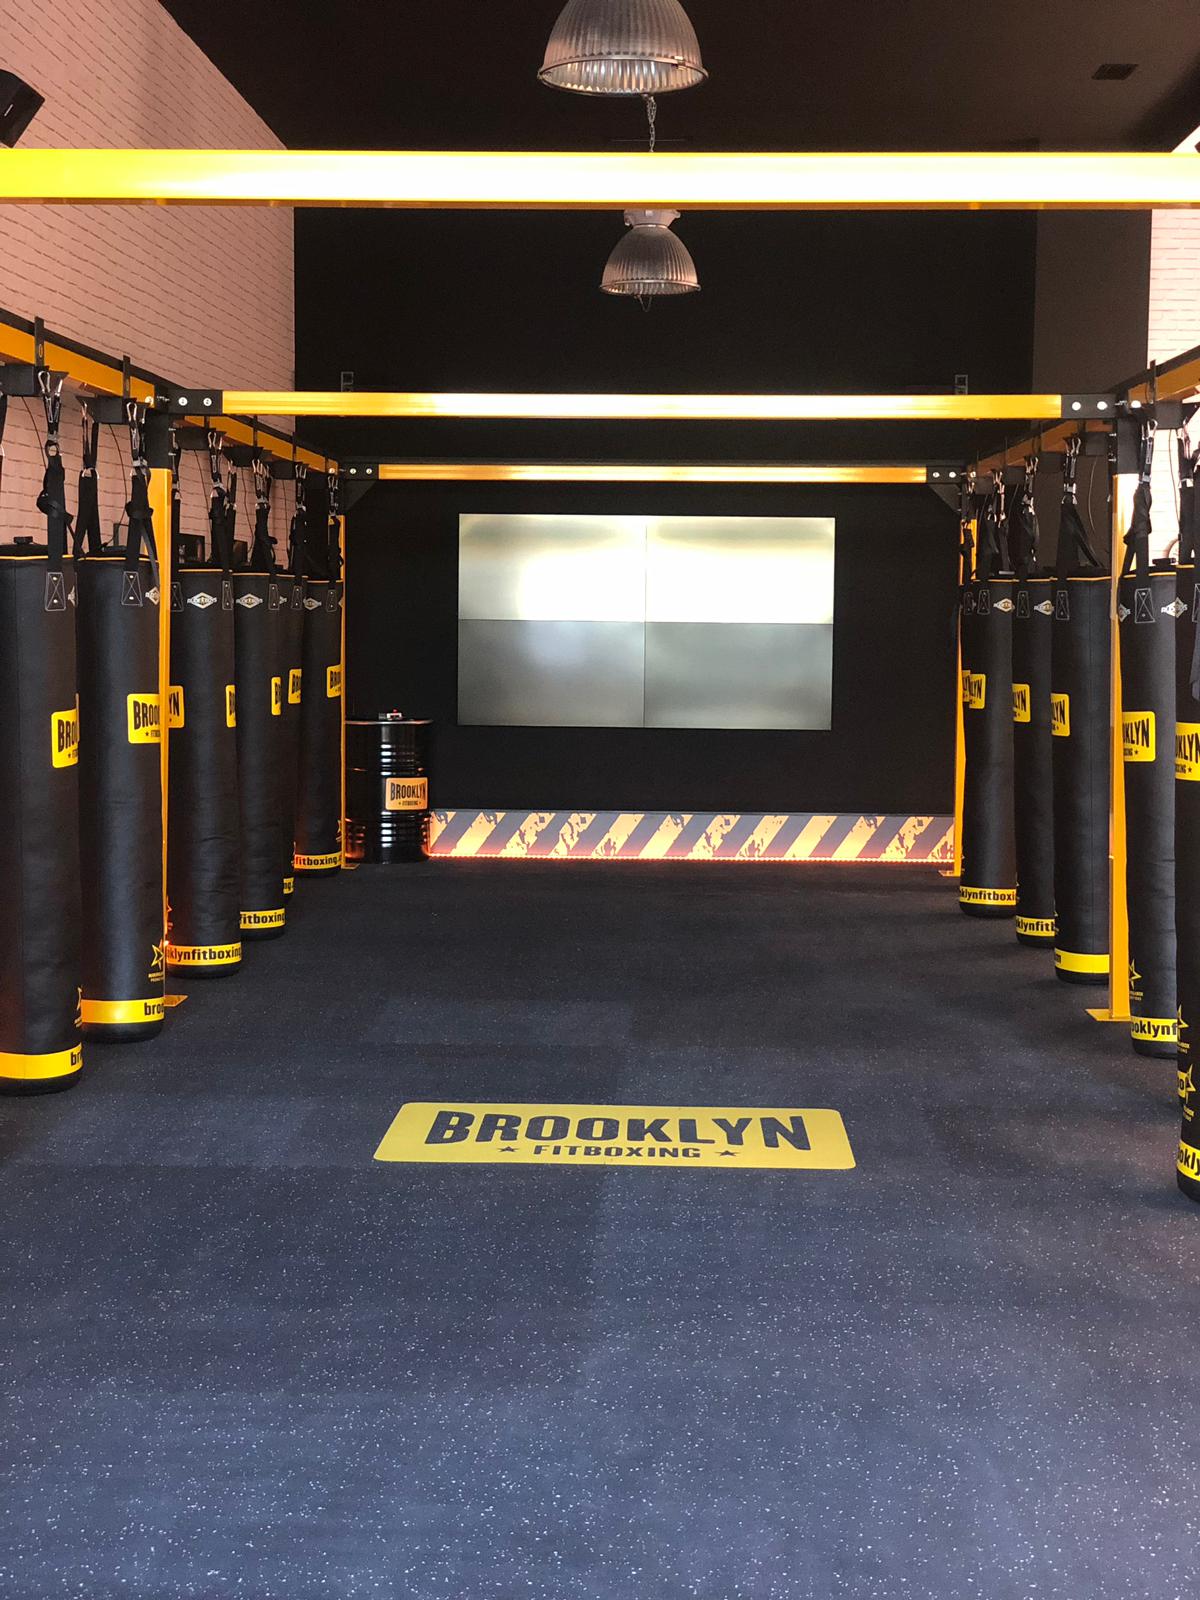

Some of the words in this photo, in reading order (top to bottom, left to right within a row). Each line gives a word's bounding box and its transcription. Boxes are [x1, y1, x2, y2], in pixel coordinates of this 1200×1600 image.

[391, 781, 427, 801] BROOKLYN
[424, 1110, 811, 1151] BROOKLYN
[533, 1144, 701, 1159] FITBOXING
